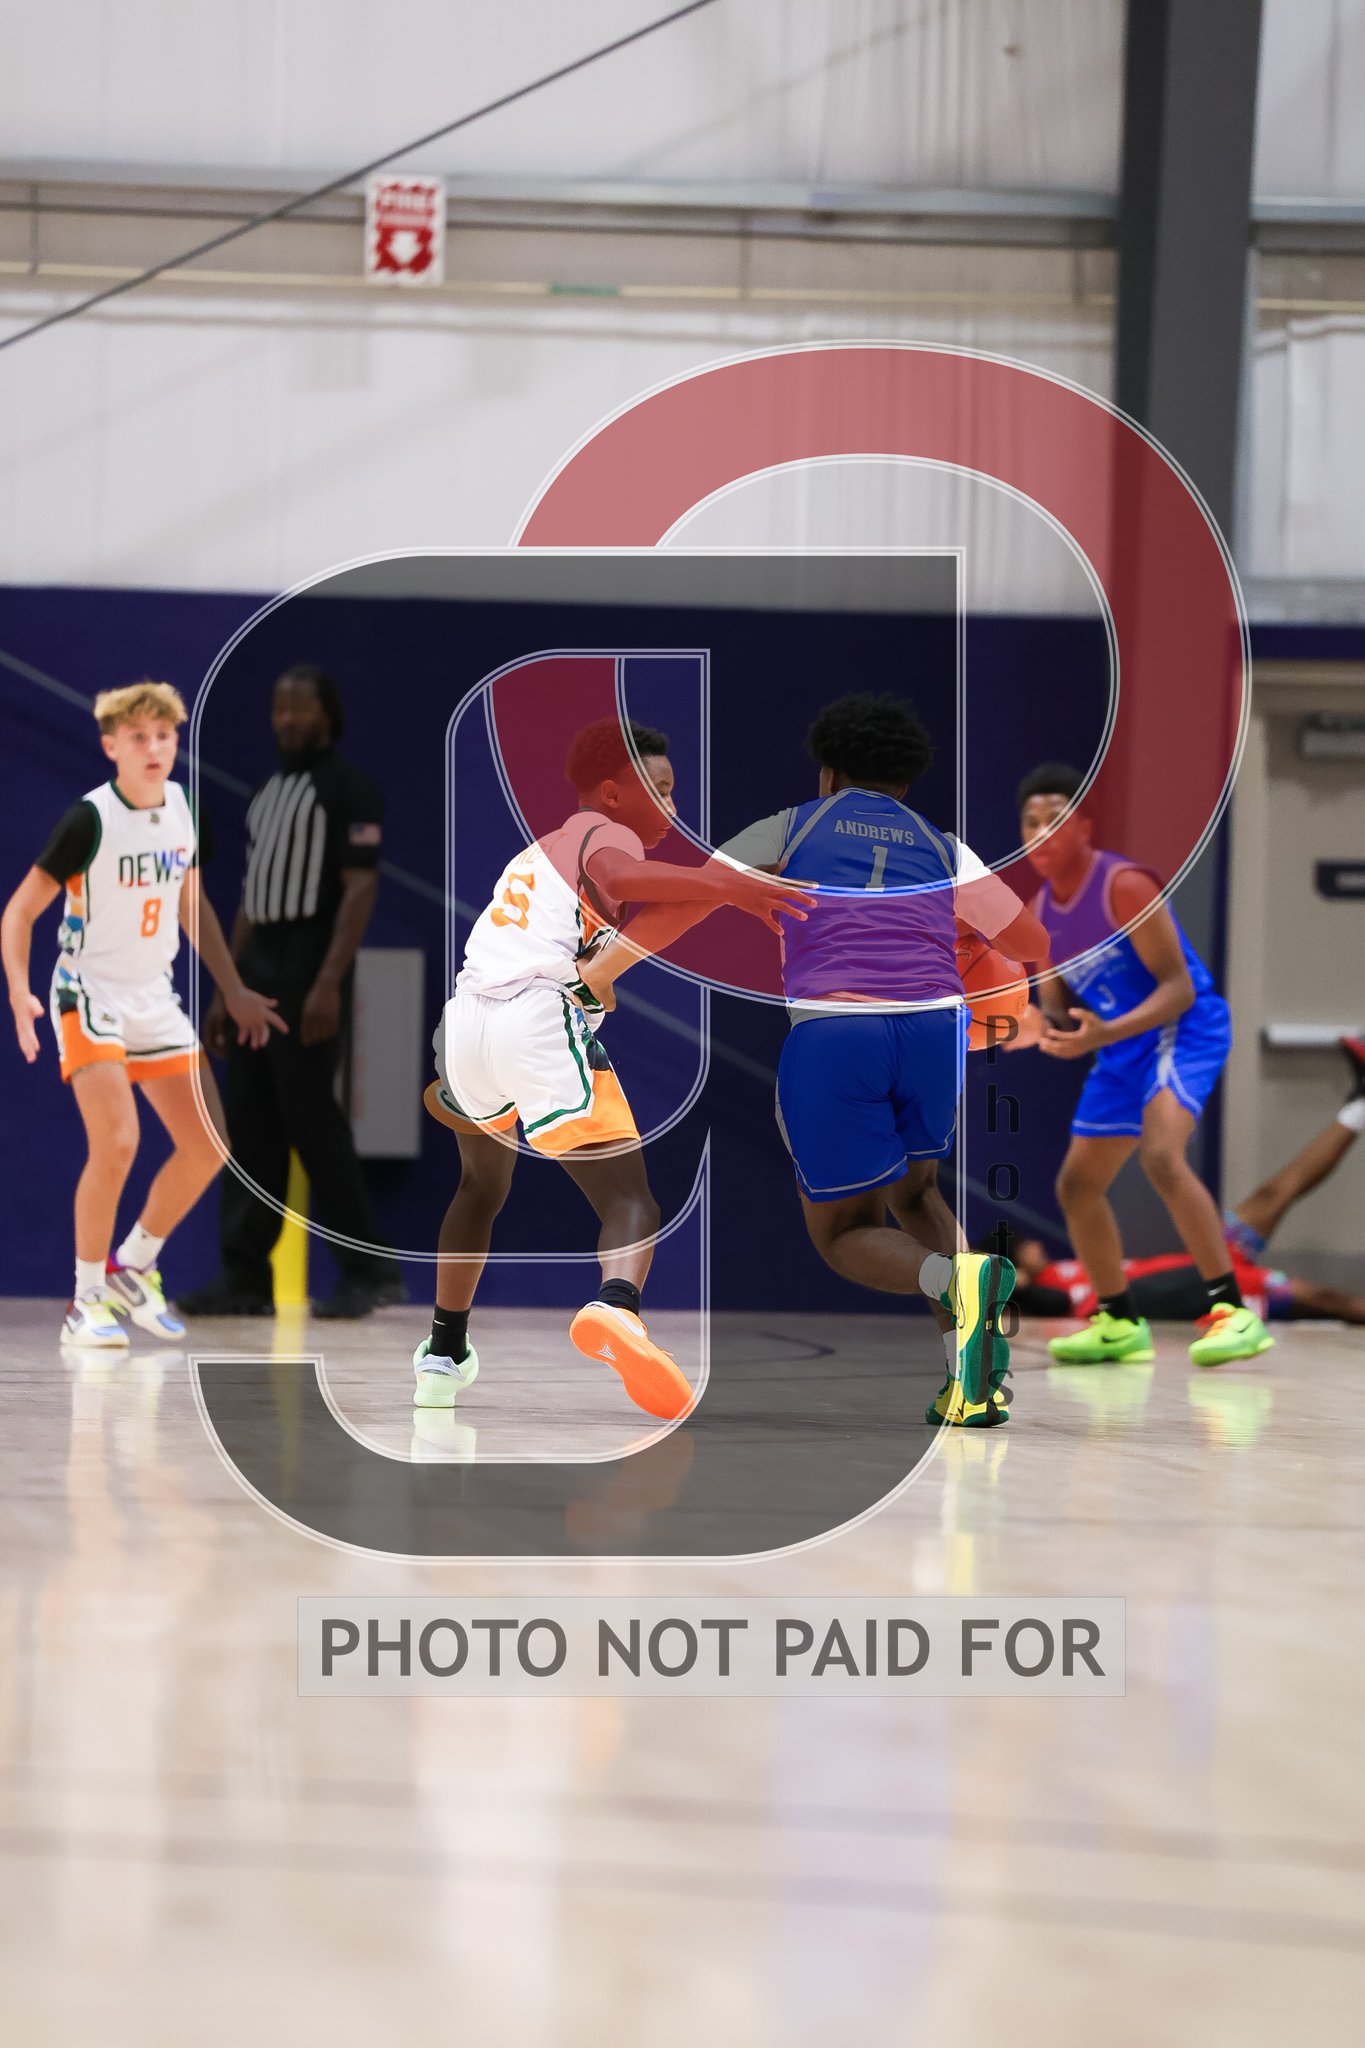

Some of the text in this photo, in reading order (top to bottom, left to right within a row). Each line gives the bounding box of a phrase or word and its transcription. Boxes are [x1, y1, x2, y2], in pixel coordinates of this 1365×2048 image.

[834, 819, 915, 847] ANDREWS
[118, 847, 187, 888] DEWS
[864, 845, 888, 892] 1
[139, 896, 162, 938] 8
[490, 872, 536, 931] 5
